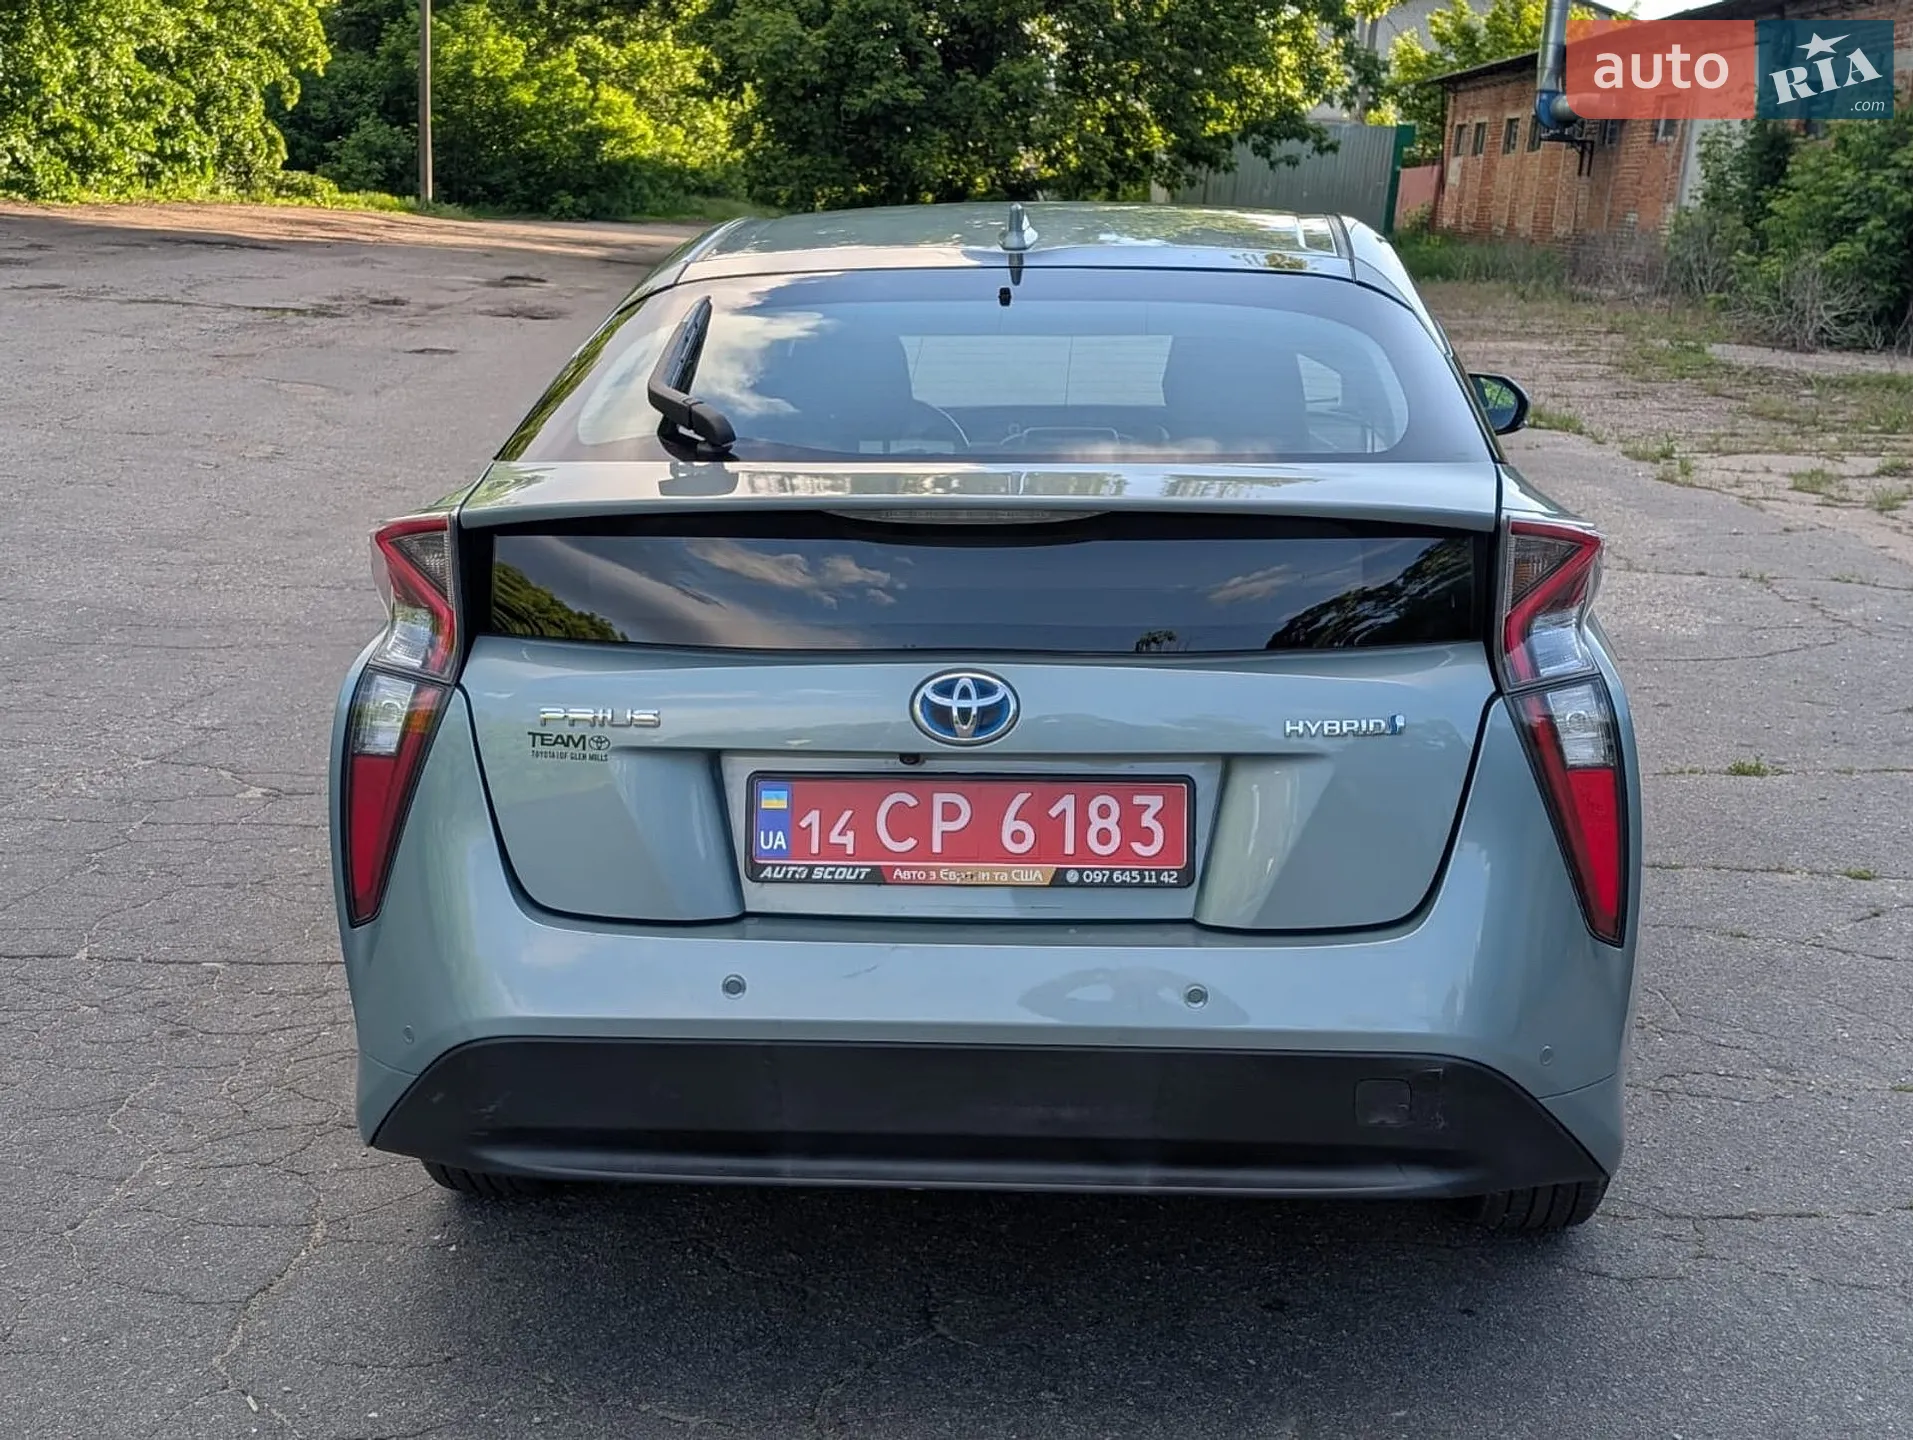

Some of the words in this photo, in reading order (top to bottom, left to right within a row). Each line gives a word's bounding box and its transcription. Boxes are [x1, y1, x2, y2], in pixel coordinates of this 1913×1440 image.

[539, 707, 661, 728] PRIUS
[1285, 718, 1387, 737] HYBRID
[528, 731, 586, 750] TEAM
[799, 809, 855, 855] 14
[1001, 792, 1165, 857] 6183
[760, 830, 786, 850] UA
[760, 866, 808, 879] AUTO
[812, 867, 871, 880] SCOUT
[893, 869, 926, 881] Авто
[993, 871, 1008, 881] та
[1012, 870, 1043, 882] США
[1083, 871, 1109, 882] 097
[1113, 871, 1140, 882] 645
[1144, 871, 1157, 883] 11
[1160, 871, 1178, 883] 42
